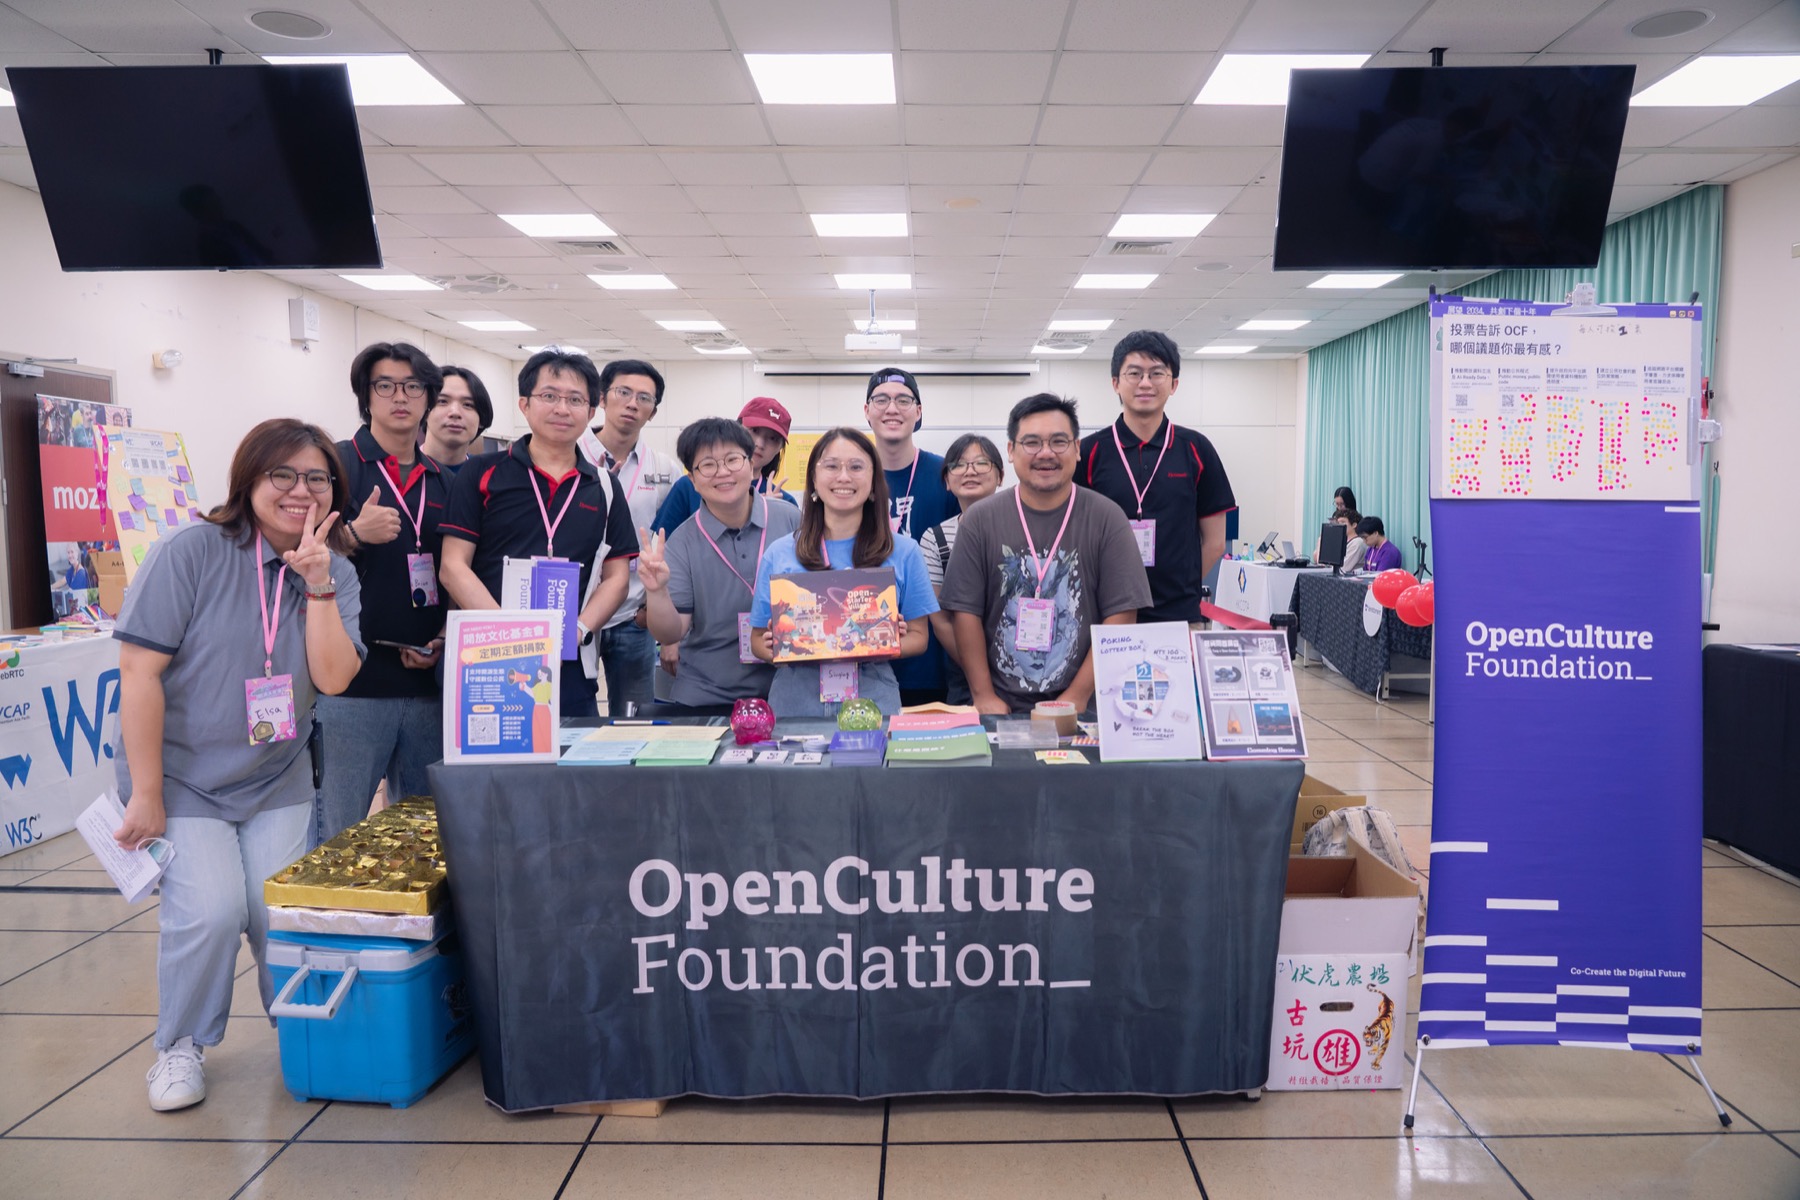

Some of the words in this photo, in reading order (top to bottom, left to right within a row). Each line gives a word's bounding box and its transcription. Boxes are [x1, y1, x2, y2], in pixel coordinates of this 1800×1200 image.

[1450, 323, 1500, 337] 投票告訴
[463, 625, 545, 646] 開放文化基金會
[1465, 621, 1654, 652] OpenCulture
[479, 641, 546, 660] 定期定額捐款
[0, 668, 24, 680] ebRTC
[255, 707, 282, 720] Elsa
[5, 814, 42, 848] W3C
[628, 855, 1095, 930] OpenCulture
[1570, 966, 1612, 977] Co-Create
[1613, 967, 1628, 977] the
[1628, 968, 1657, 979] Digital
[1658, 969, 1687, 979] Future
[1282, 998, 1310, 1061] 古坑
[1321, 1035, 1352, 1069] 雄
